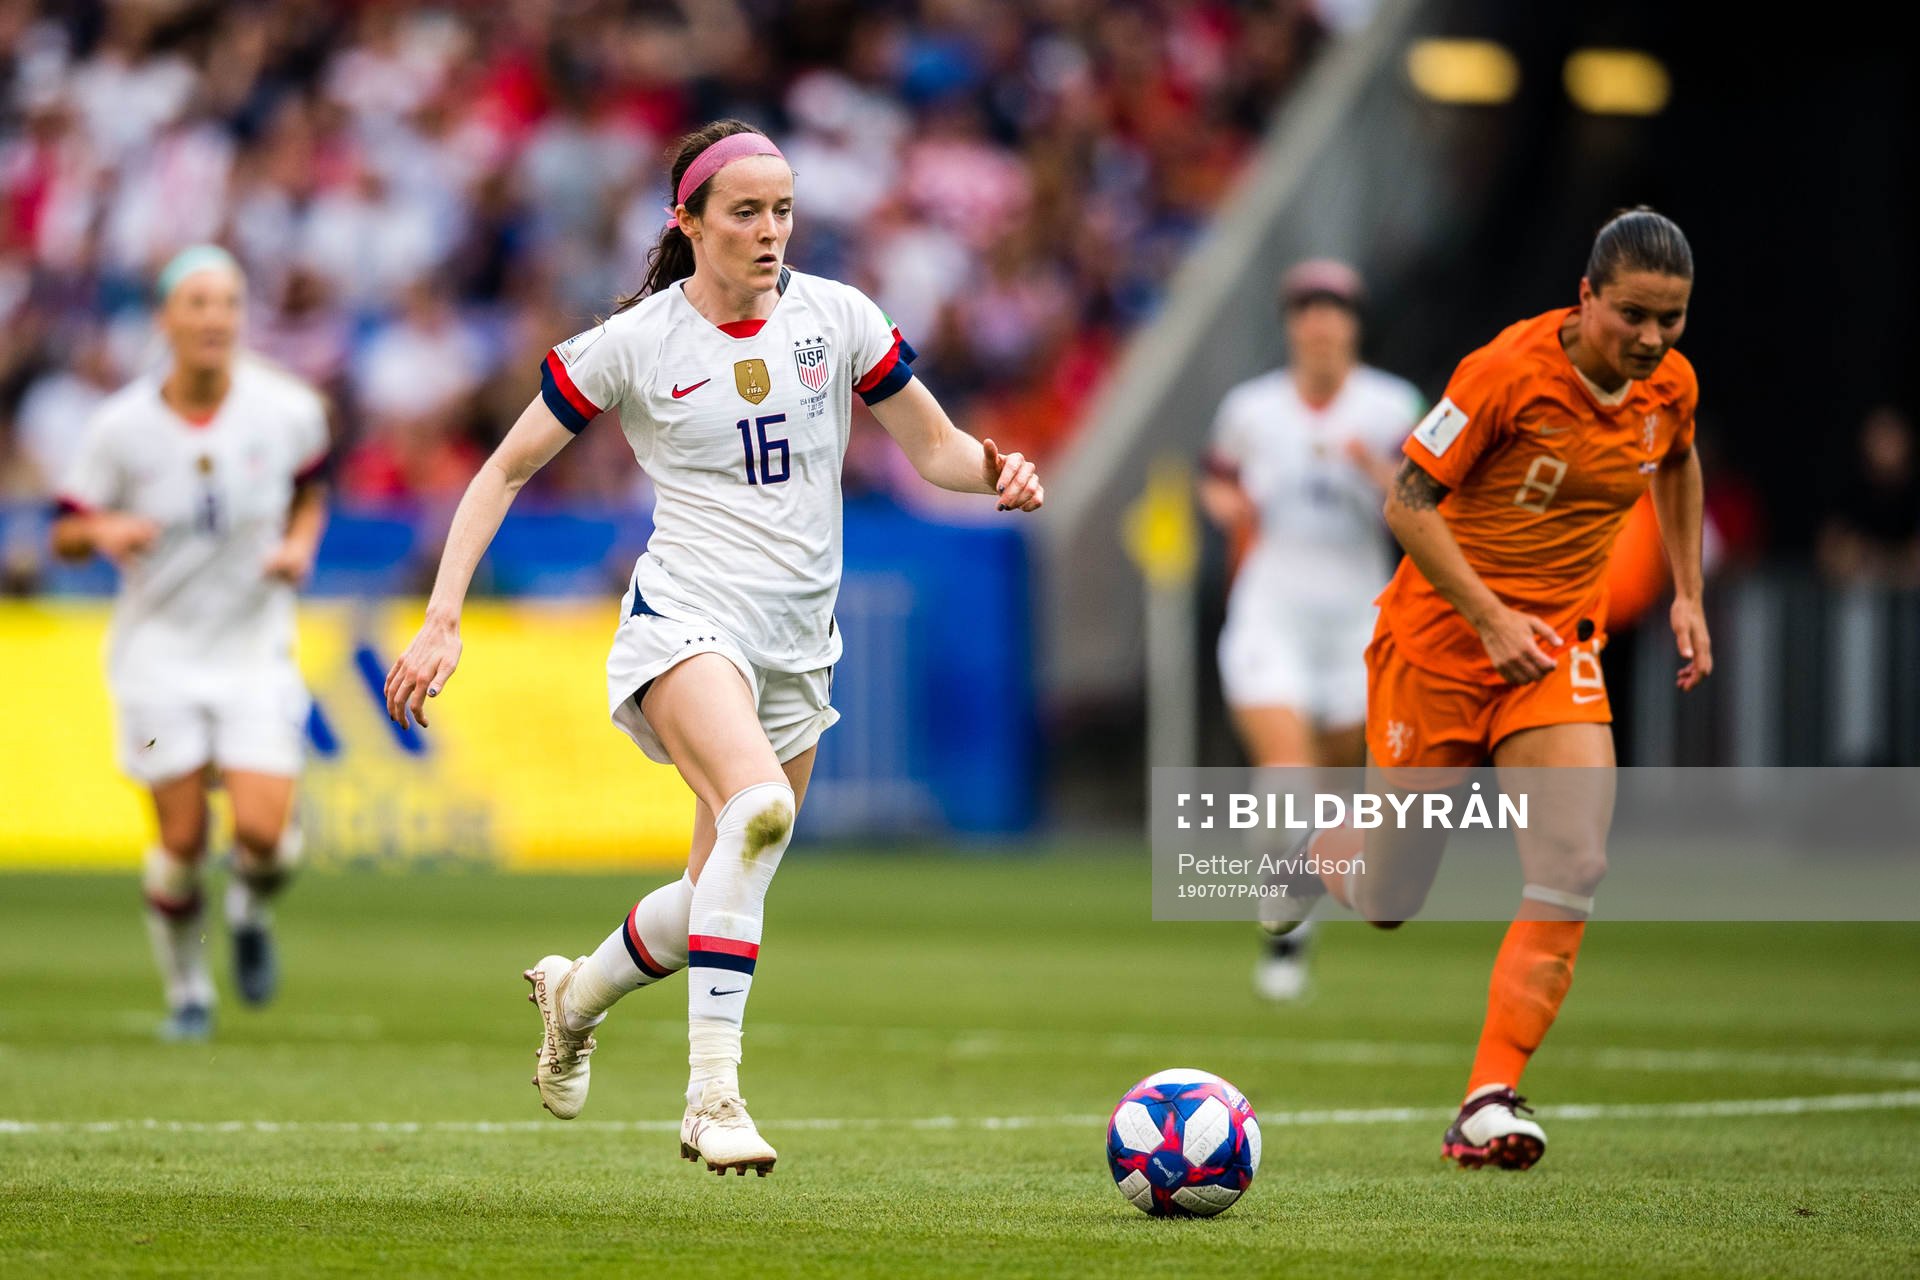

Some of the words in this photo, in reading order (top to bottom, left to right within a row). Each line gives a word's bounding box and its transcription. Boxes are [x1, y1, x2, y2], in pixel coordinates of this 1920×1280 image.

[798, 349, 824, 367] USA
[746, 386, 763, 394] FIFA
[736, 412, 791, 486] 16
[1514, 456, 1568, 514] 8
[536, 971, 548, 1006] new
[543, 1009, 562, 1075] balance
